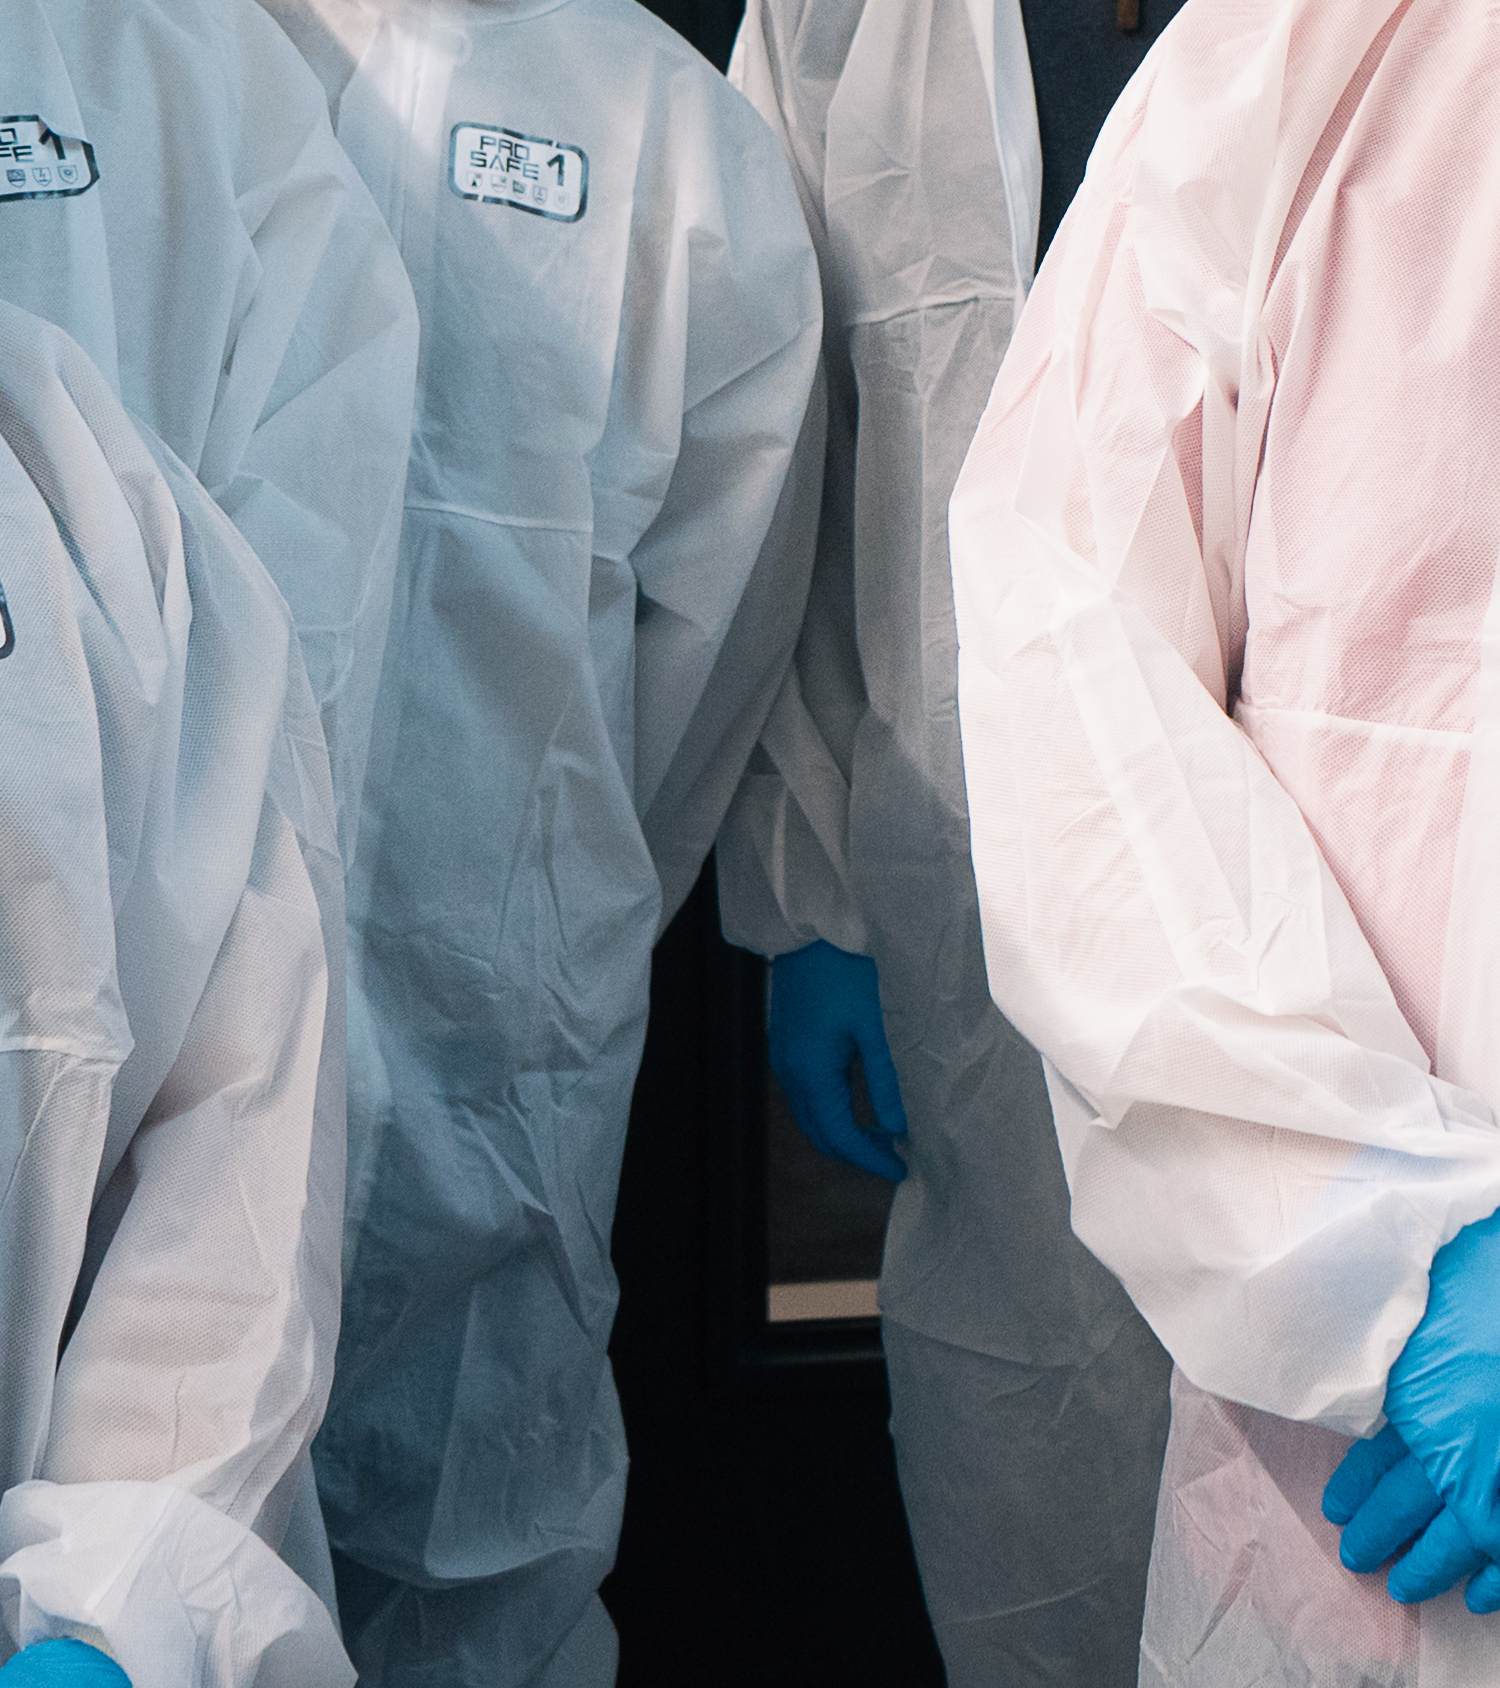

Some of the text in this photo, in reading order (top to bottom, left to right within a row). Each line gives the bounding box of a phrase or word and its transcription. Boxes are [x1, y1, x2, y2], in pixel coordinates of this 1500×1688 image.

[479, 135, 530, 160] PRO
[470, 151, 540, 181] SAFE
[546, 153, 565, 187] 1
